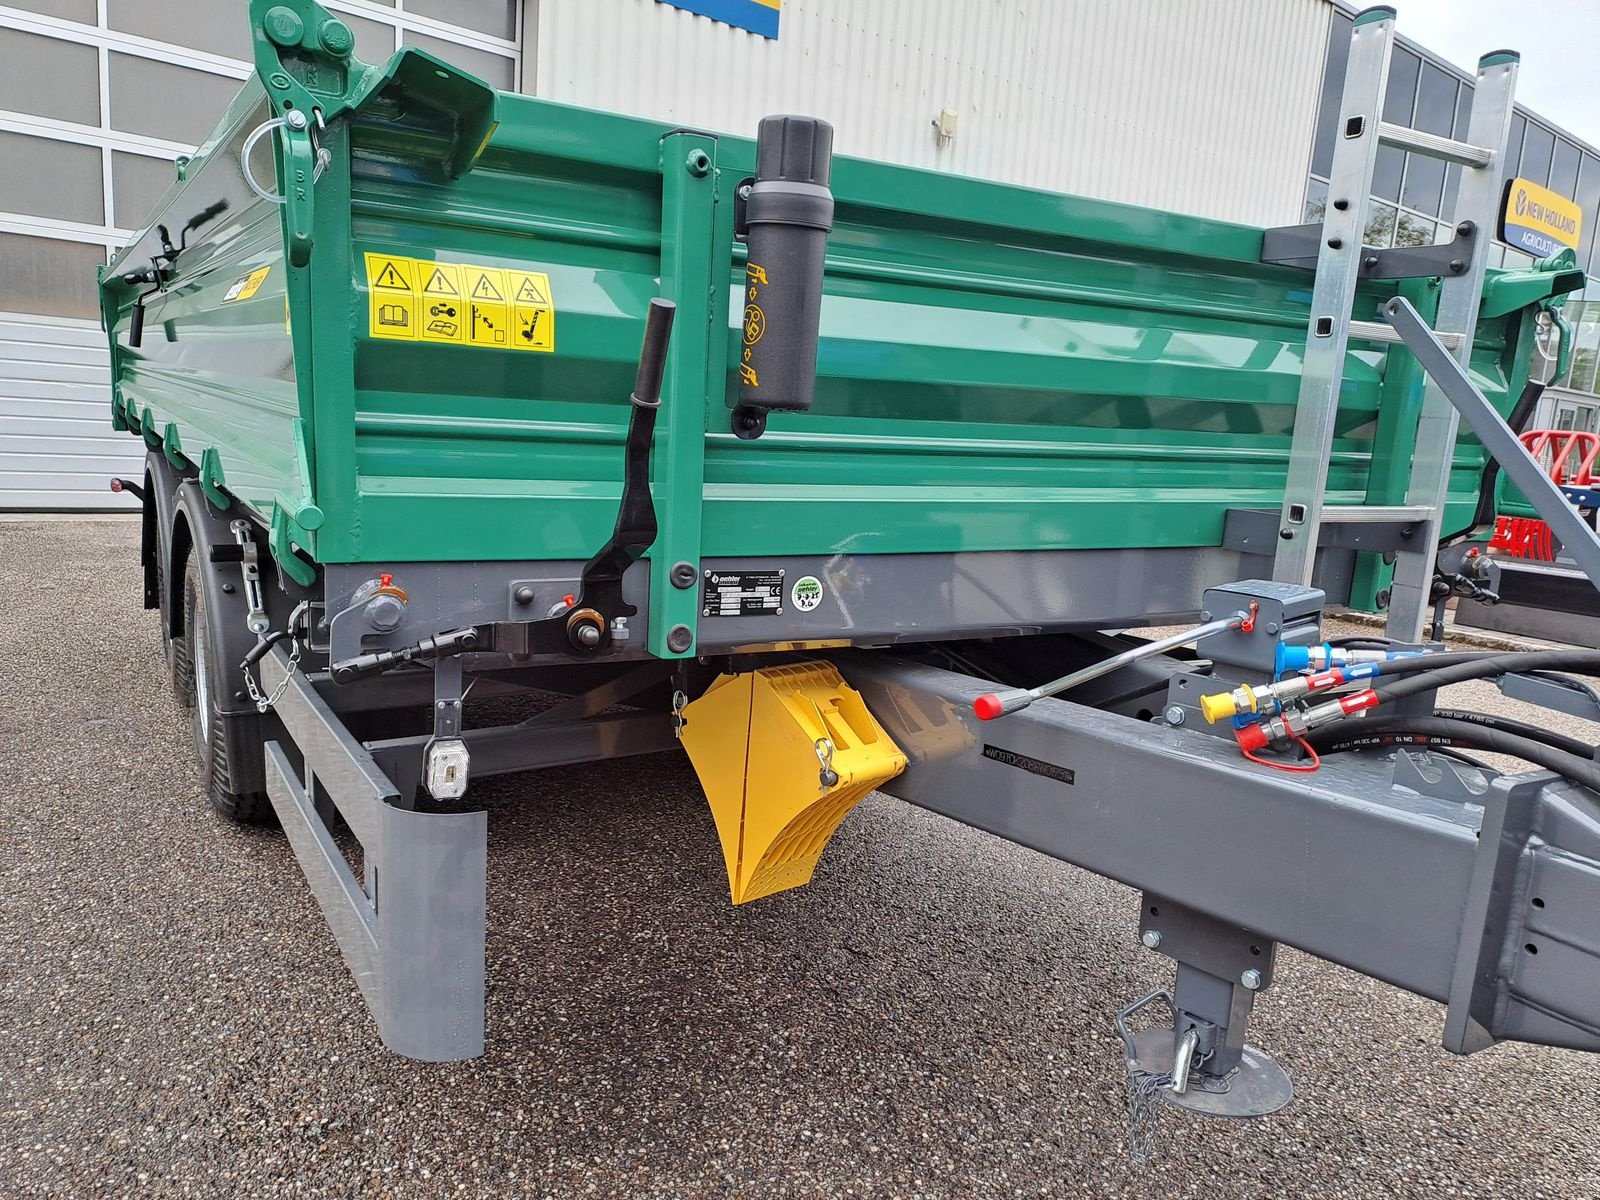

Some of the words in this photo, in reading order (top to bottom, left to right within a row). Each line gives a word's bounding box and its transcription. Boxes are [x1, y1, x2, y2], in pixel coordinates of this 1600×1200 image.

[1526, 200, 1545, 222] NEW
[1544, 207, 1576, 235] HOLLAND
[1468, 714, 1485, 722] 4785
